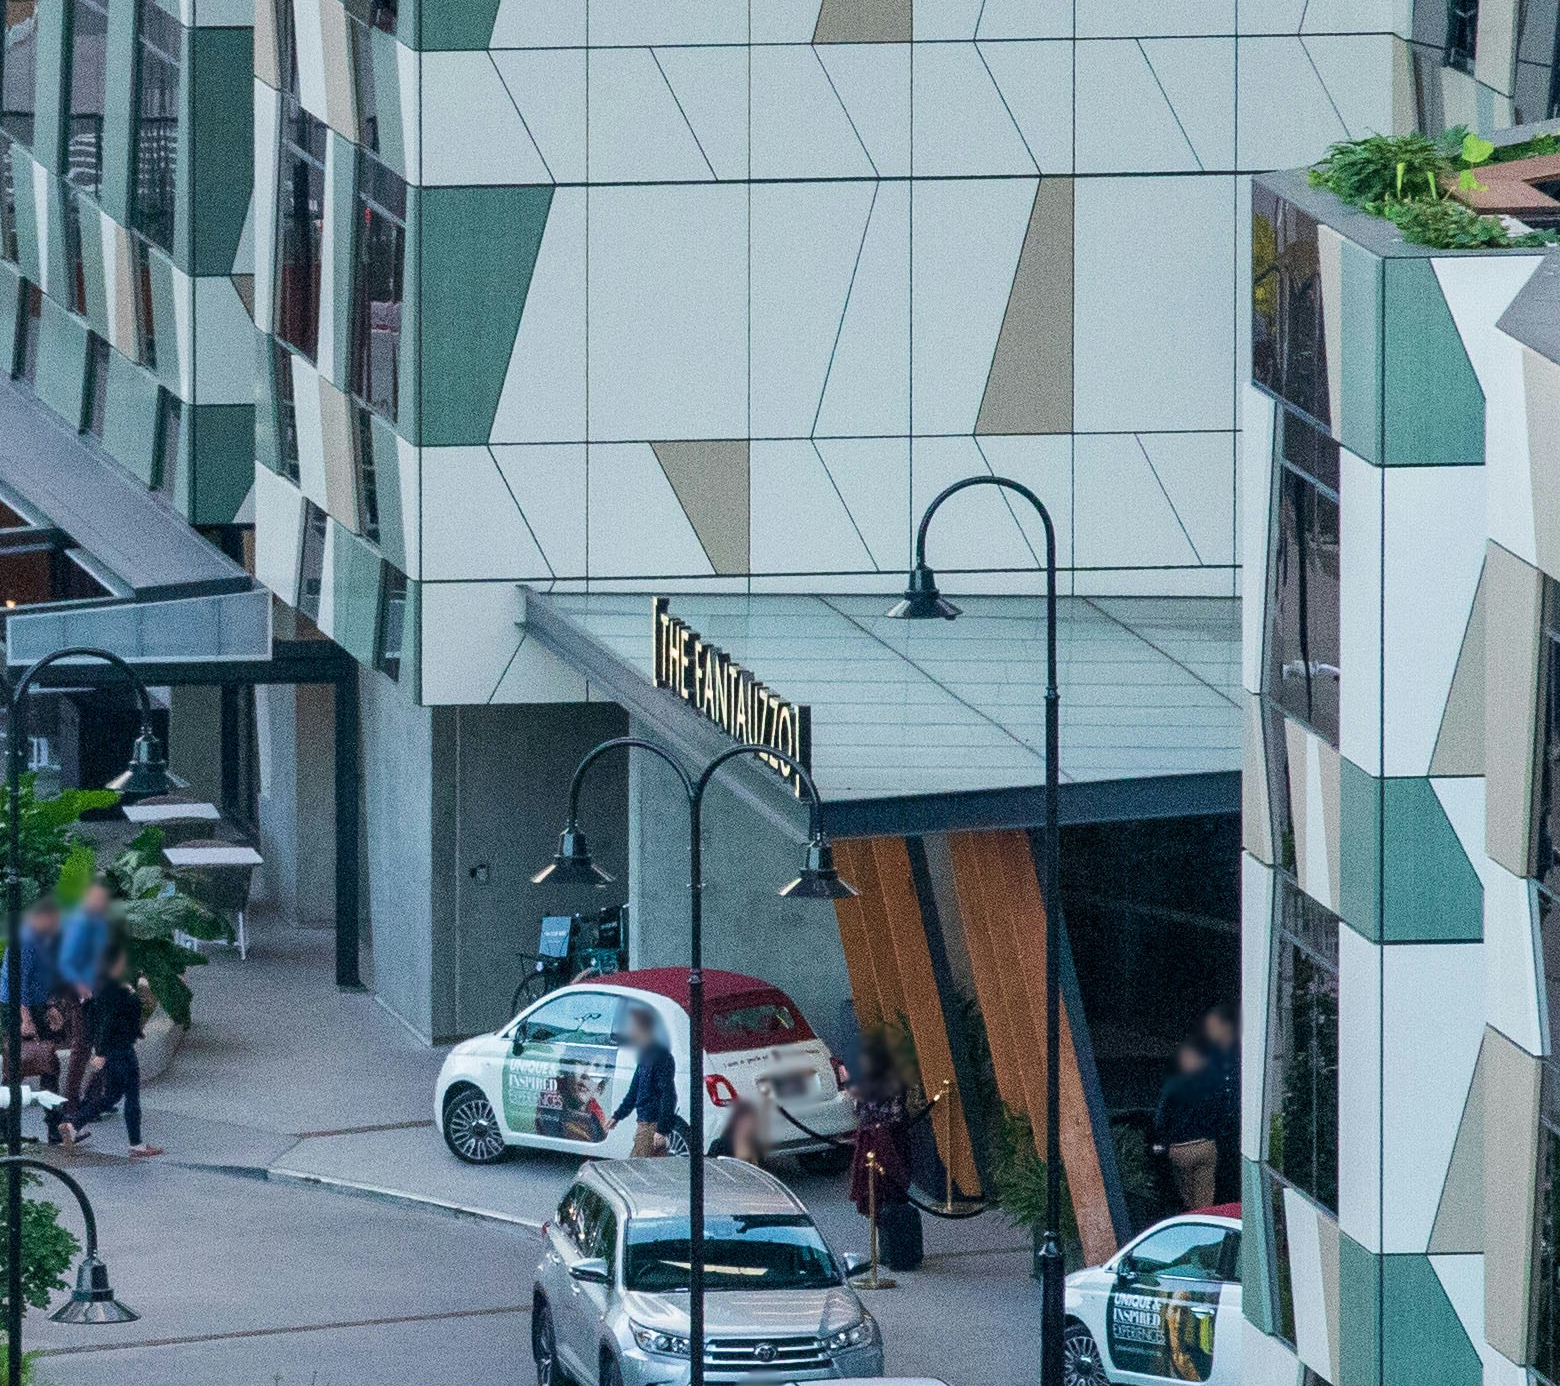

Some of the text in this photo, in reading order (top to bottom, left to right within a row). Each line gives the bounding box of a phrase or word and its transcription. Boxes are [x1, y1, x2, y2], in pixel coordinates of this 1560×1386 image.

[510, 1059, 549, 1076] UNIQUE
[509, 1074, 558, 1091] INSPIRED
[1114, 1293, 1152, 1310] UNIQUE
[1113, 1307, 1161, 1325] INSPIRED
